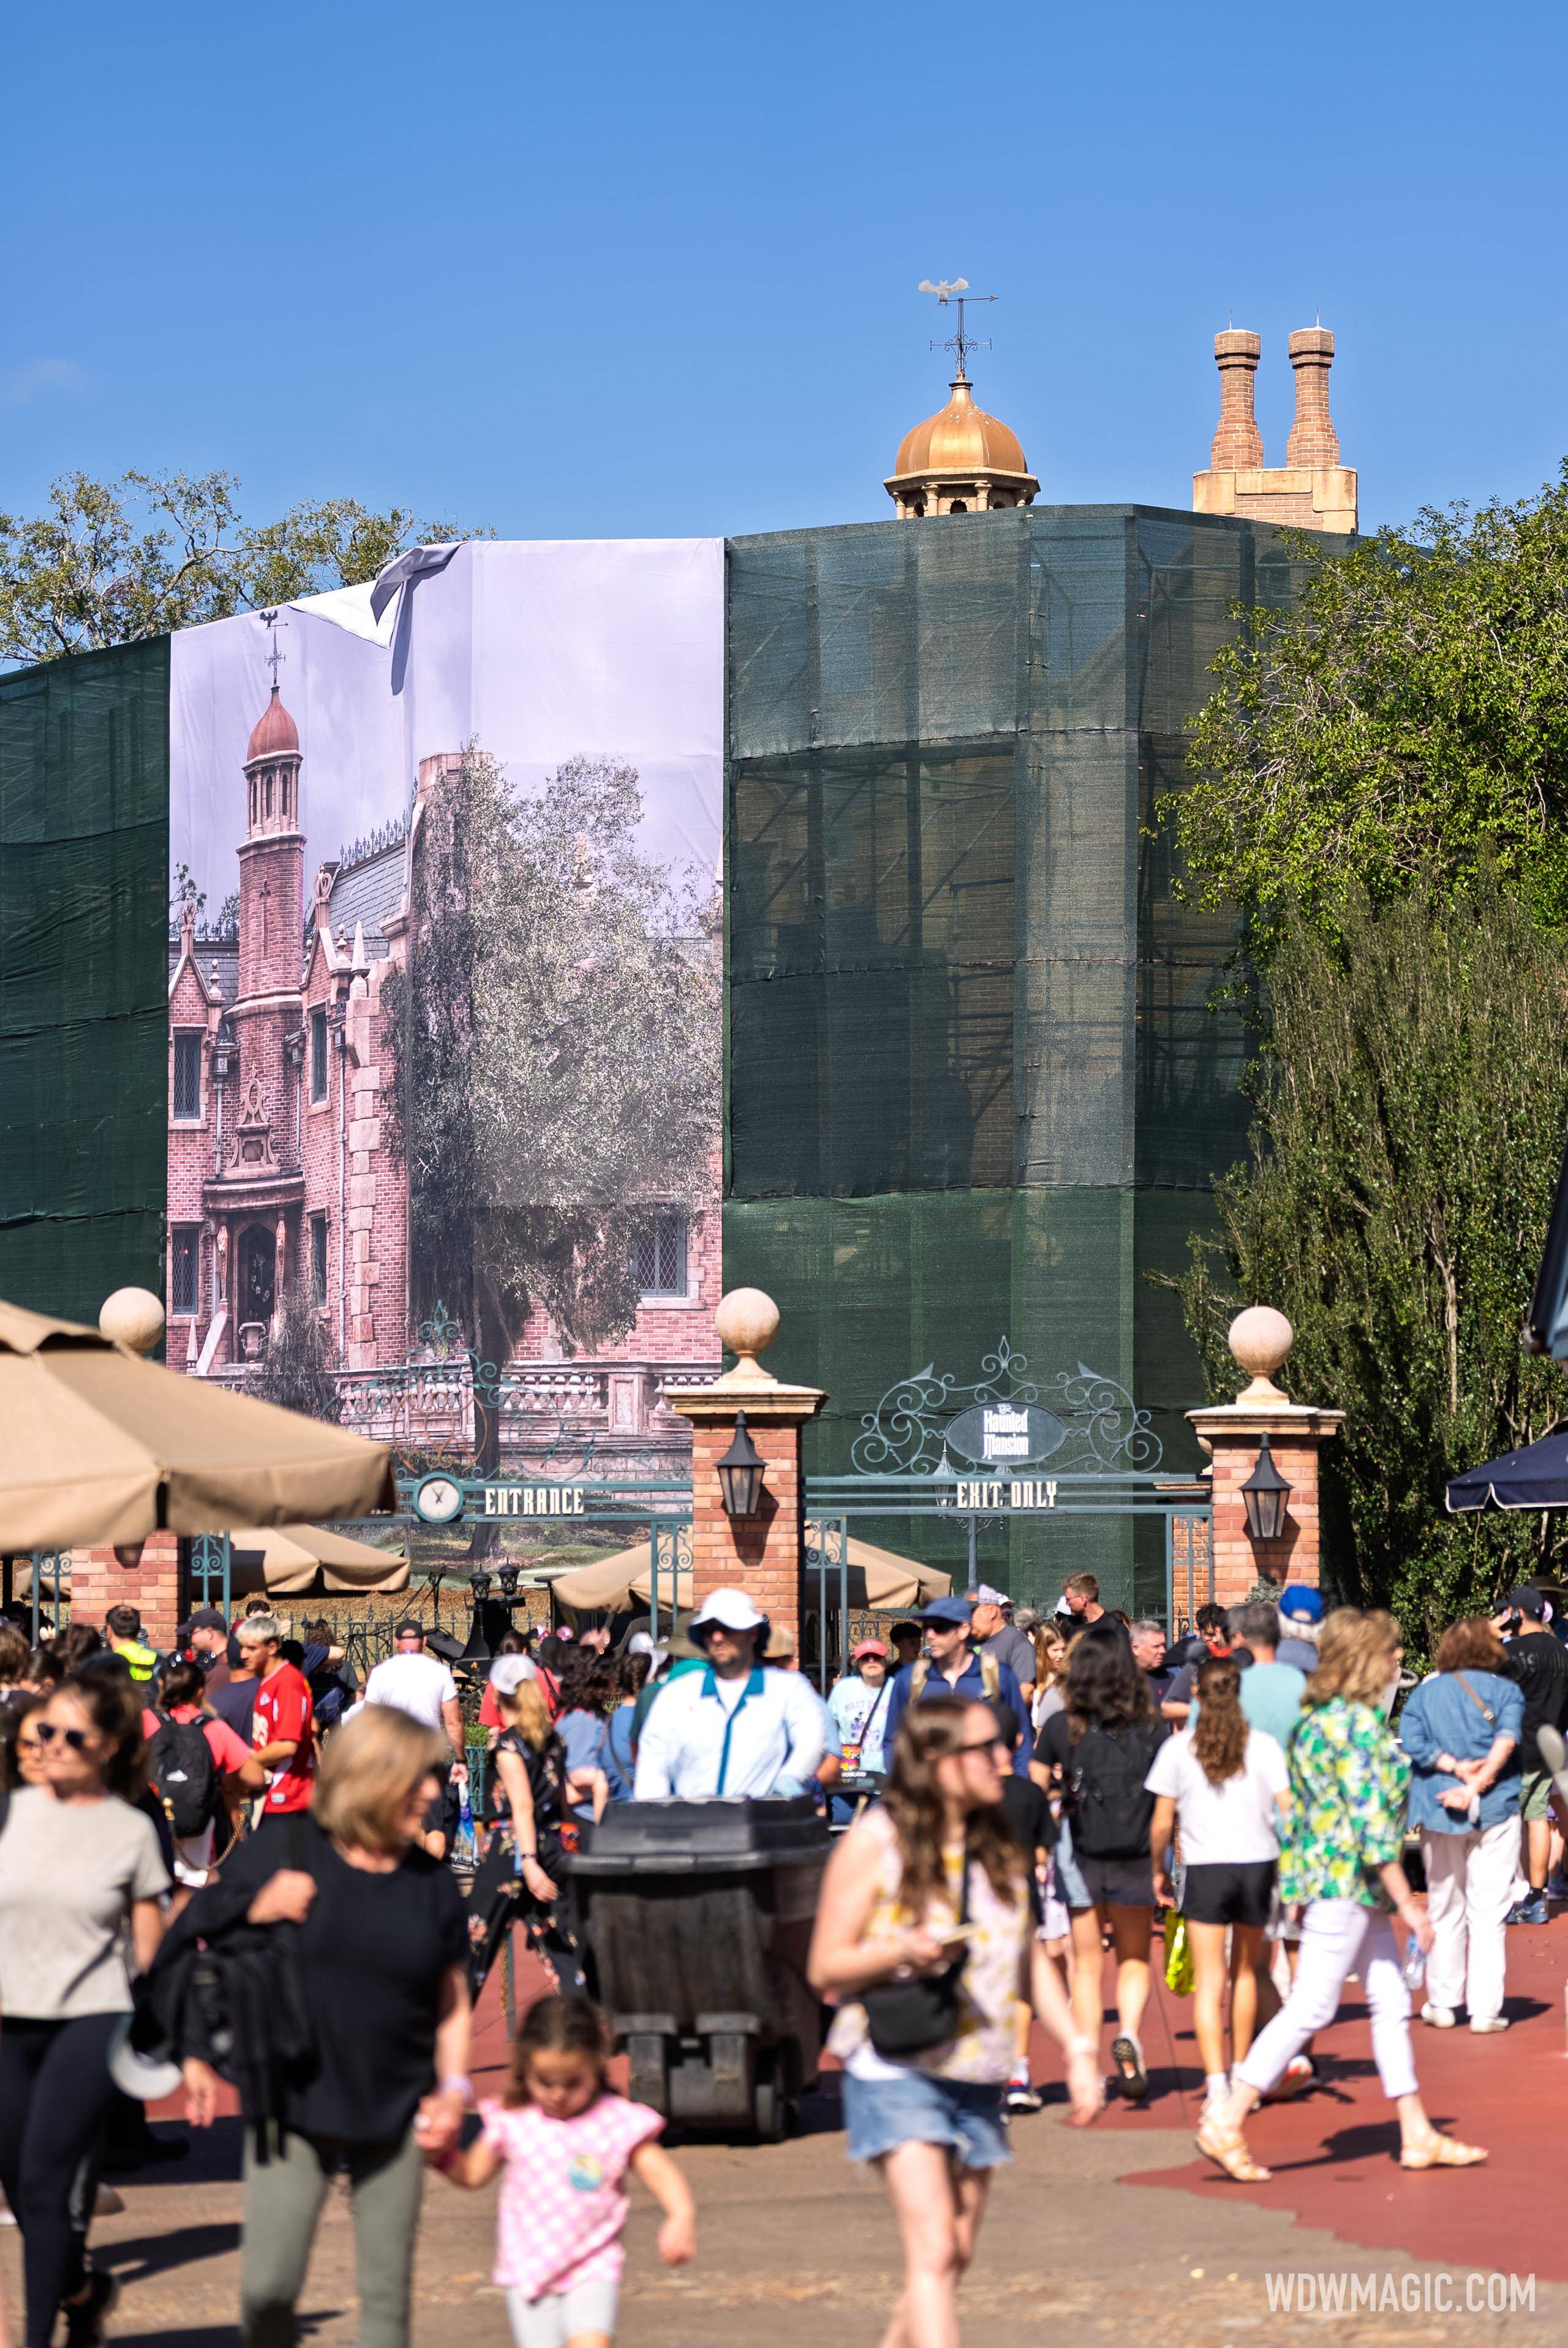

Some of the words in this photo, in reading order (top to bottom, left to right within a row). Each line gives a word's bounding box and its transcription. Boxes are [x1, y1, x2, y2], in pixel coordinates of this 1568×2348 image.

[984, 1409, 1029, 1433] Haunted
[982, 1433, 1029, 1460] Mansion
[484, 1488, 584, 1516] ENTRANCE
[957, 1481, 1002, 1509] EXIT
[1011, 1481, 1058, 1509] ONLY
